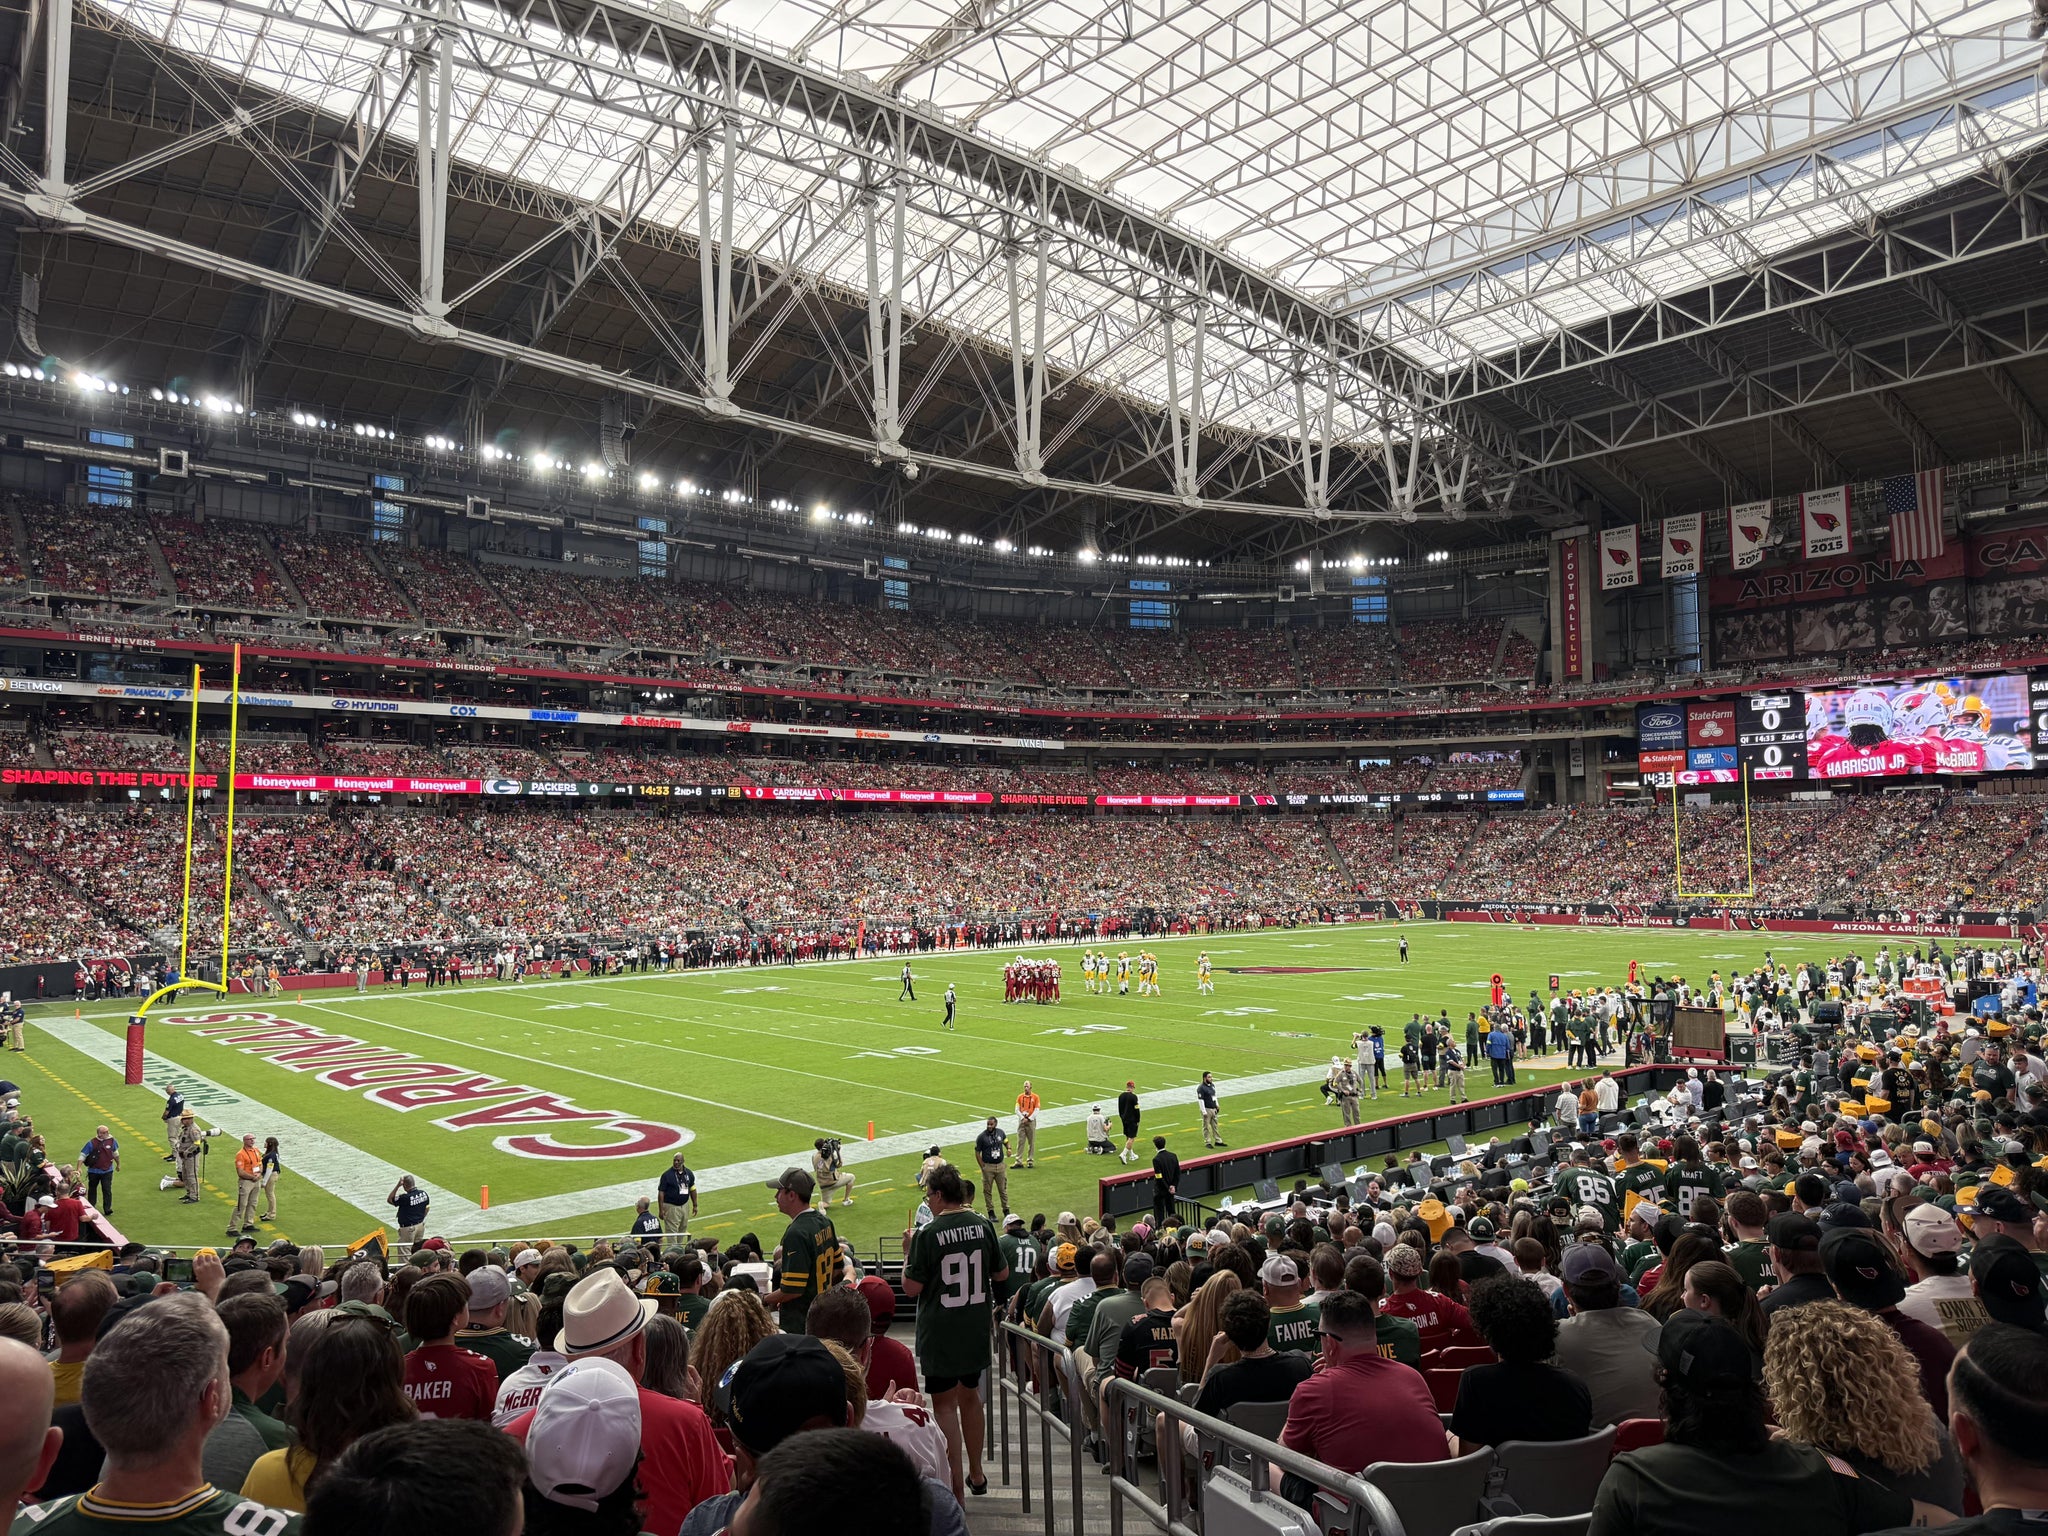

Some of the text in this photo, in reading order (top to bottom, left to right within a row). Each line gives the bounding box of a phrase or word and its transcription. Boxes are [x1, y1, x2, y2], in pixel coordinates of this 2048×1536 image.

[1808, 491, 1840, 503] NFC WEST
[1808, 497, 1841, 508] DIVISION
[1748, 504, 1766, 512] WEST
[1735, 509, 1767, 521] DIVISION
[1604, 533, 1633, 543] DIVISION
[1616, 528, 1632, 536] WEST
[1810, 535, 1843, 545] CHAMPIONS
[1810, 540, 1843, 554] 2015
[1666, 562, 1695, 575] 2008
[1738, 537, 2048, 606] ARIZONA CA
[1606, 574, 1634, 587] 2008
[1567, 552, 1577, 632] FOOTBALL
[79, 634, 112, 644] ERNIE
[114, 636, 157, 647] NEVERS
[1569, 633, 1579, 673] CLUB
[435, 662, 454, 670] DAN
[455, 663, 497, 673] DIERDORF
[1936, 662, 2002, 674] RING OF HONOR
[1796, 673, 1872, 686] ARIZONA CARDINALS
[10, 679, 63, 693] BETMGM
[693, 682, 743, 692] LARRY WILSON
[97, 687, 167, 699] desert FINANCIAL
[244, 695, 294, 707] Albertsons
[351, 700, 399, 712] HYUNDAI
[449, 705, 478, 717] COX
[530, 711, 578, 722] BUD LIGHT
[1415, 706, 1482, 716] MARSHALL GOLDBERG
[1761, 710, 1781, 731] 0
[1017, 738, 1046, 750] AVNET
[1754, 734, 1775, 744] 14:33
[1694, 757, 1715, 765] LIGHT
[1762, 746, 1782, 767] 0
[1935, 751, 1978, 768] McBRIDE
[1826, 753, 1906, 777] HARRISON JR
[1, 769, 218, 789] SHAPING THE FUTURE
[253, 776, 316, 789] Honeywell
[333, 778, 393, 790] Honeywell
[1643, 771, 1674, 786] 14:33
[410, 779, 466, 792] Honeywell
[531, 782, 599, 795] PACKERS 0
[627, 785, 633, 795] 1
[639, 784, 670, 796] 14:33
[755, 787, 817, 798] 0 CARDINALS
[854, 791, 890, 800] Honeywell
[900, 792, 935, 801] Honeywell
[944, 793, 976, 802] Honeywell
[1320, 794, 1369, 803] M. WILSON
[1430, 793, 1442, 801] 96
[1000, 794, 1088, 805] SHAPING THE FUTURE
[1106, 795, 1142, 804] Honeywell
[1151, 795, 1186, 804] Honeywell
[1195, 795, 1230, 804] Honeywell
[1622, 917, 1673, 926] CARDNALS
[1832, 923, 1883, 933] ARIZONA
[1888, 924, 1947, 935] CARDNAL
[1551, 976, 1558, 986] 2
[1830, 974, 1839, 984] 23
[1040, 1023, 1128, 1037] 20
[856, 1045, 943, 1059] 10
[158, 1011, 696, 1161] CARDINALS
[1636, 1170, 1657, 1184] KRAFT
[1681, 1169, 1703, 1181] KRAFT
[1576, 1175, 1611, 1206] 85
[936, 1224, 985, 1247] WYNTHEIN
[1017, 1237, 1032, 1246] LOVE
[1015, 1246, 1037, 1274] 10
[940, 1248, 987, 1309] 91
[1939, 1300, 1976, 1319] OWN
[1427, 1311, 1440, 1327] JR
[1150, 1326, 1177, 1342] WAR
[1274, 1319, 1315, 1344] FAVRE
[403, 1380, 453, 1403] BAKER
[502, 1386, 543, 1414] McBR
